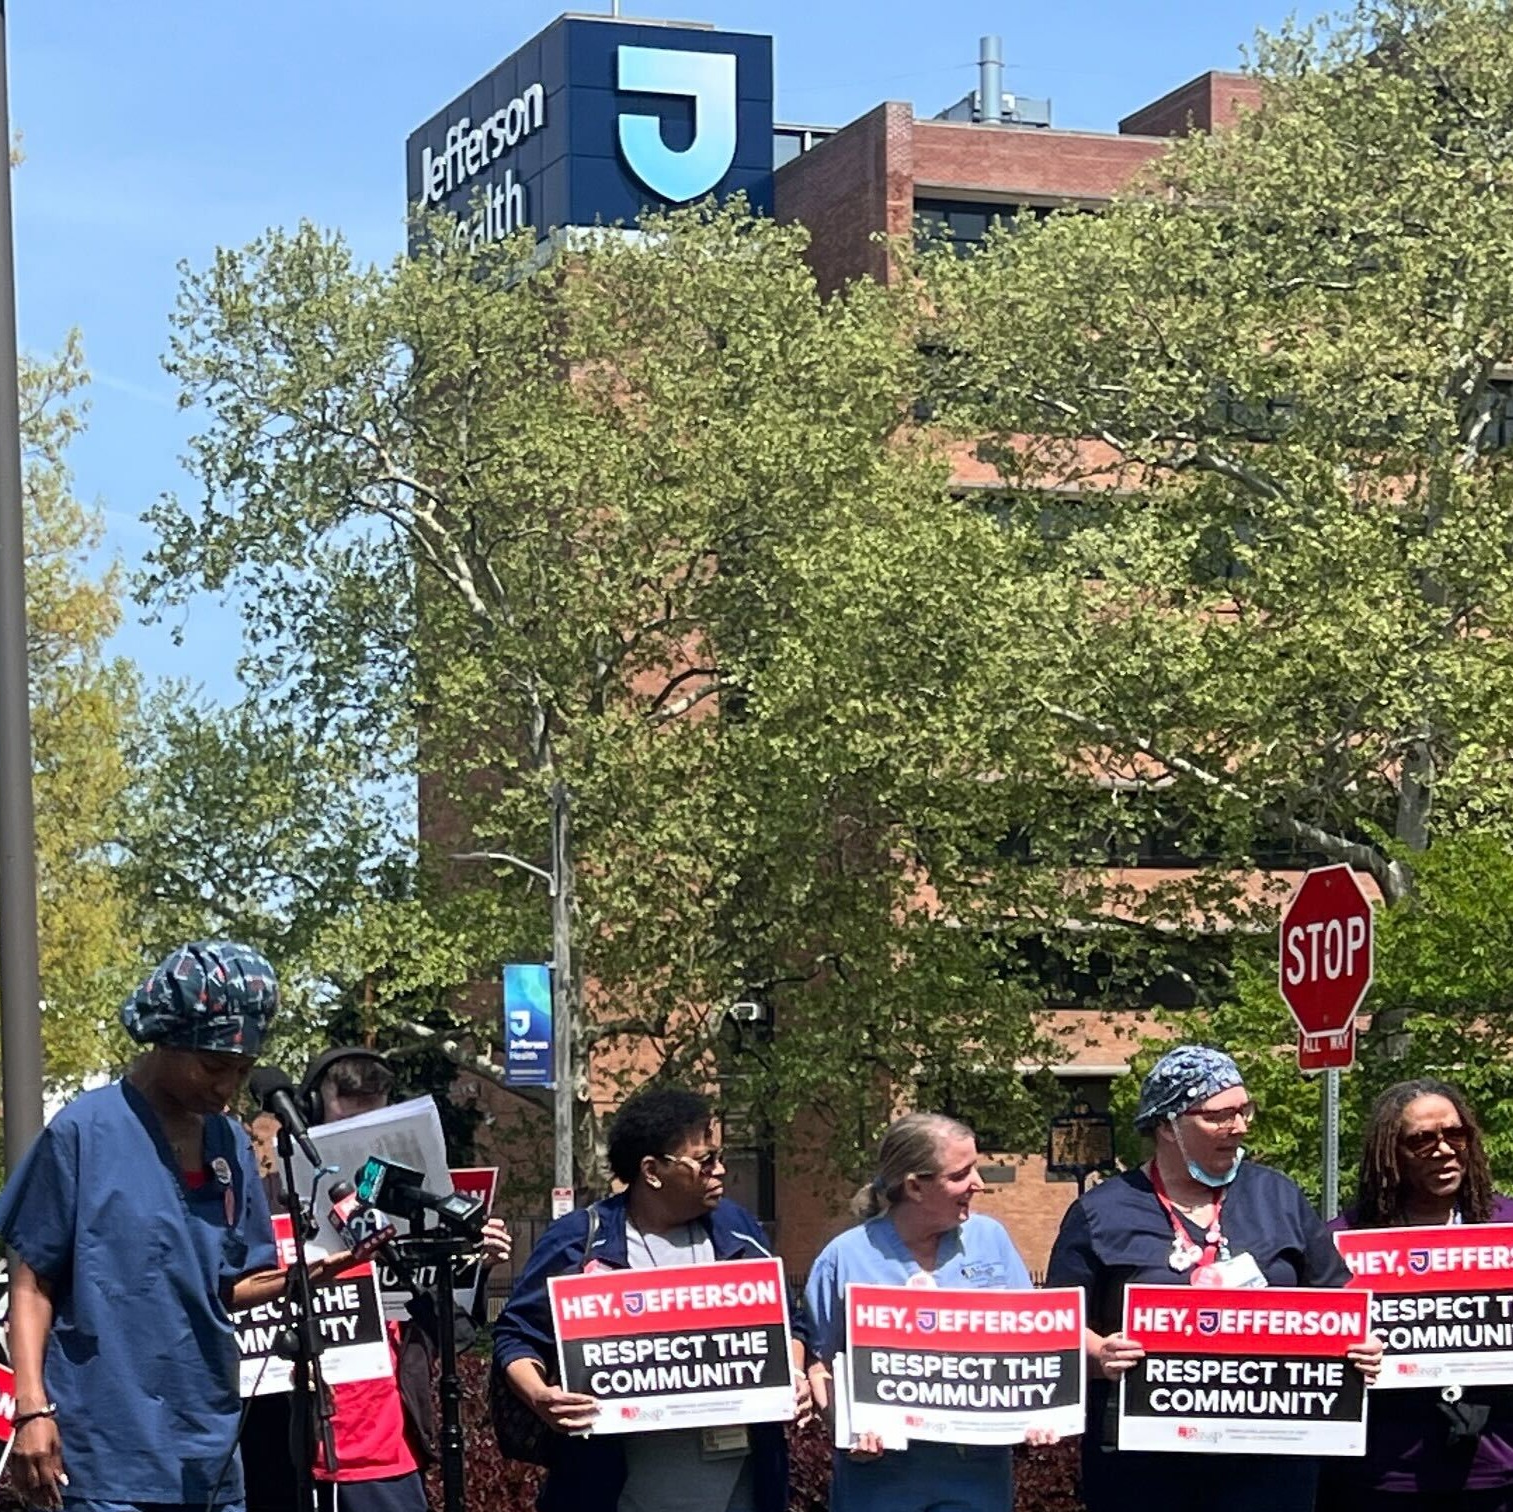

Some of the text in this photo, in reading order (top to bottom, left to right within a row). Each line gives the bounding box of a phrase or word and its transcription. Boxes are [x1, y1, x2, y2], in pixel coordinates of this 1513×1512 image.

[417, 83, 544, 210] Jefferson
[449, 169, 523, 256] ealth
[1286, 916, 1366, 985] STOP
[1302, 1031, 1350, 1053] ALL WAY
[1345, 1245, 1513, 1277] HEY, JEFFER
[561, 1279, 777, 1321] HEY, JEFFERSON
[1370, 1296, 1490, 1323] RESPECT
[855, 1304, 1076, 1334] HEY, JEFFERSON
[1132, 1307, 1361, 1337] HEY, JEFFERSON
[582, 1330, 769, 1367] RESPECT THE
[1371, 1323, 1513, 1350] COMMUNI
[590, 1360, 766, 1395] COMMUNITY
[871, 1351, 1062, 1381] RESPECT THE
[1145, 1358, 1344, 1387] RESPECT THE
[876, 1380, 1057, 1408] COMMUNITY
[1149, 1388, 1339, 1416] COMMUNITY
